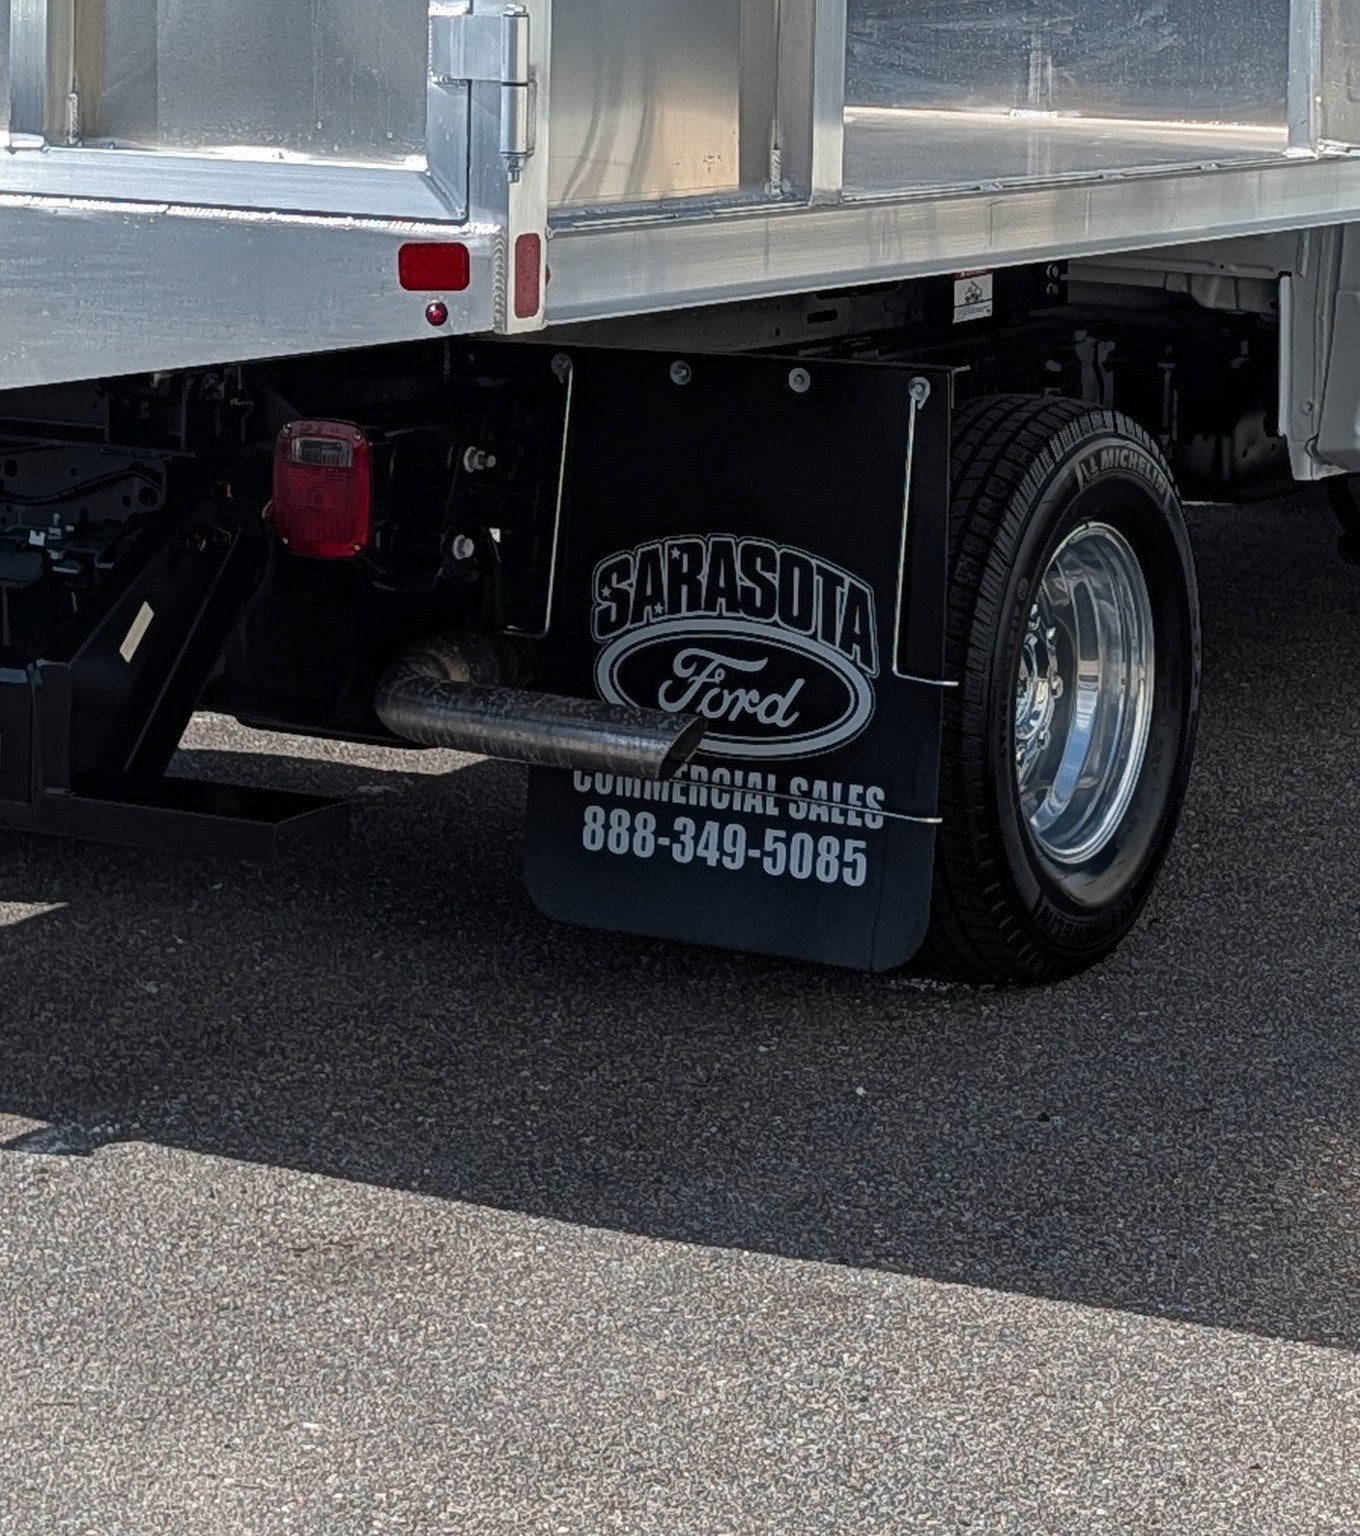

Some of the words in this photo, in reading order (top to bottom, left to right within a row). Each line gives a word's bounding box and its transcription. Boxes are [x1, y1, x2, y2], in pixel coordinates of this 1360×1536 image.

[1100, 447, 1169, 497] MICHELIN
[590, 533, 880, 678] SARASOTA
[658, 647, 805, 728] Ford
[789, 777, 886, 830] SALES
[582, 805, 868, 887] 888-349-5085
